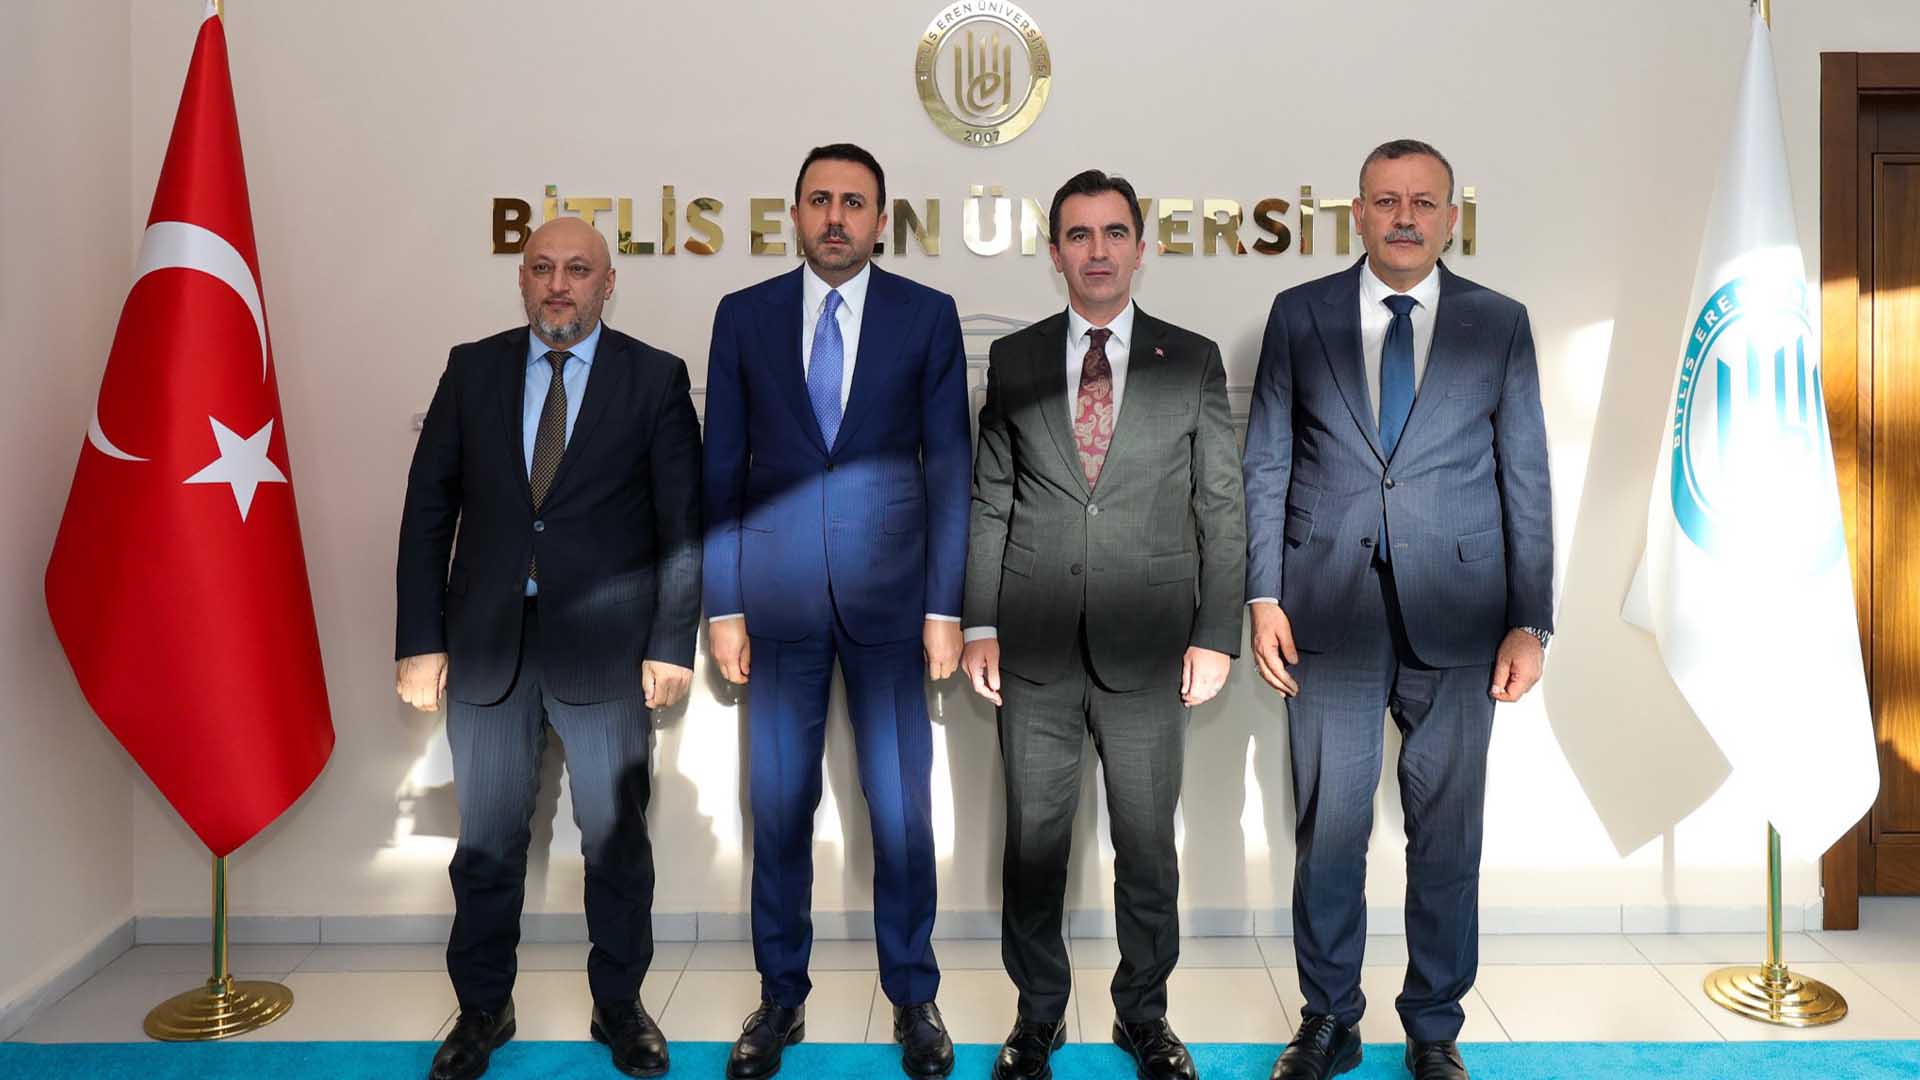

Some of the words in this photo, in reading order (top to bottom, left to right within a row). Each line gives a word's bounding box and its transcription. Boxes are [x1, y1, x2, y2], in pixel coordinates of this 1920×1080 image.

[936, 3, 972, 30] EREN
[963, 130, 1000, 143] 2007
[491, 184, 724, 256] BİTLİS
[749, 197, 941, 257] EN
